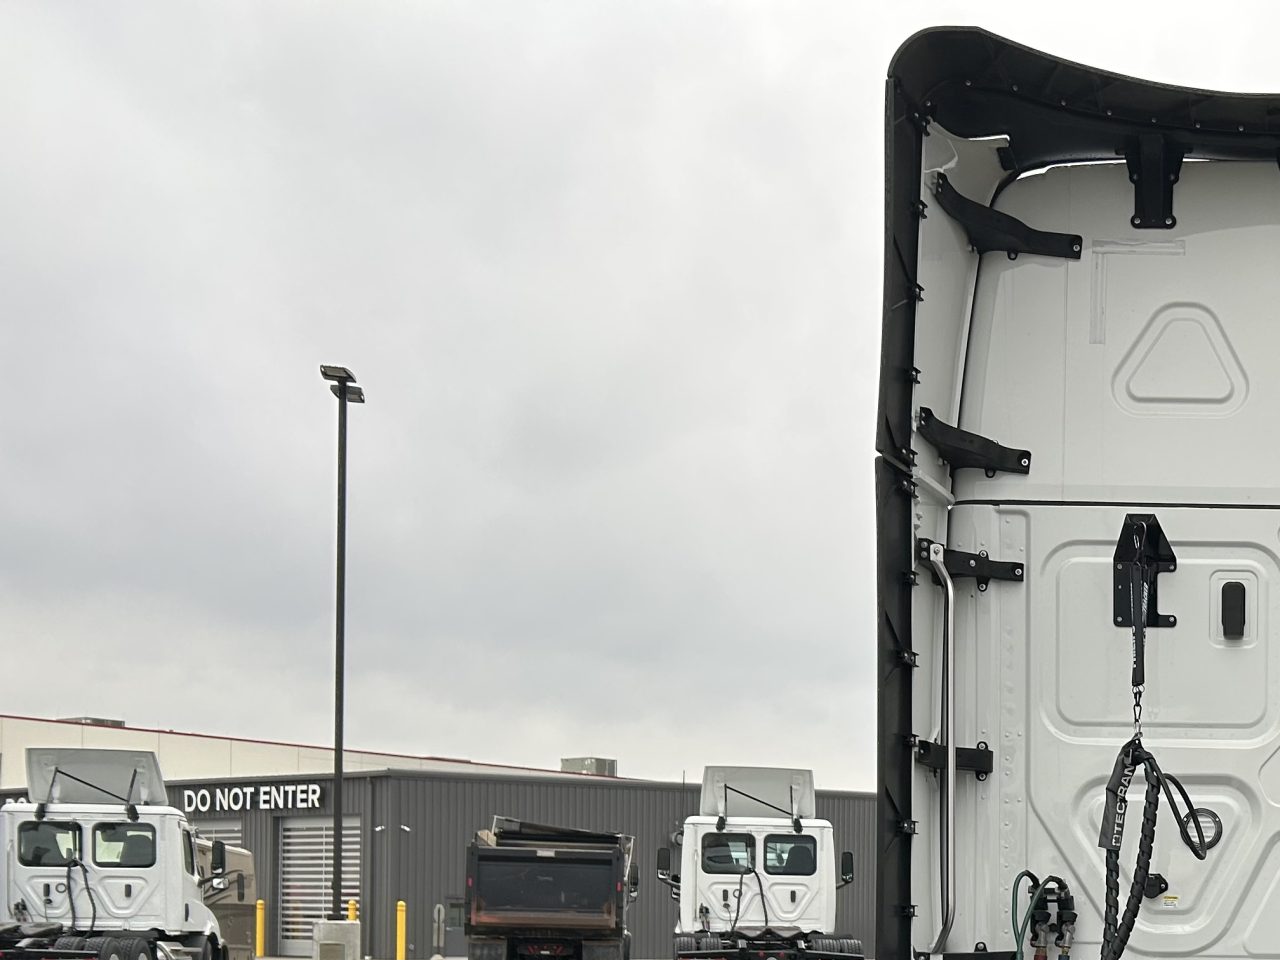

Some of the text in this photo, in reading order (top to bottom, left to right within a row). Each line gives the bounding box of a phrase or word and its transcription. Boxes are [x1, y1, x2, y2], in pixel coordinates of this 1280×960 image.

[183, 784, 321, 813] DO NOT ENTER
